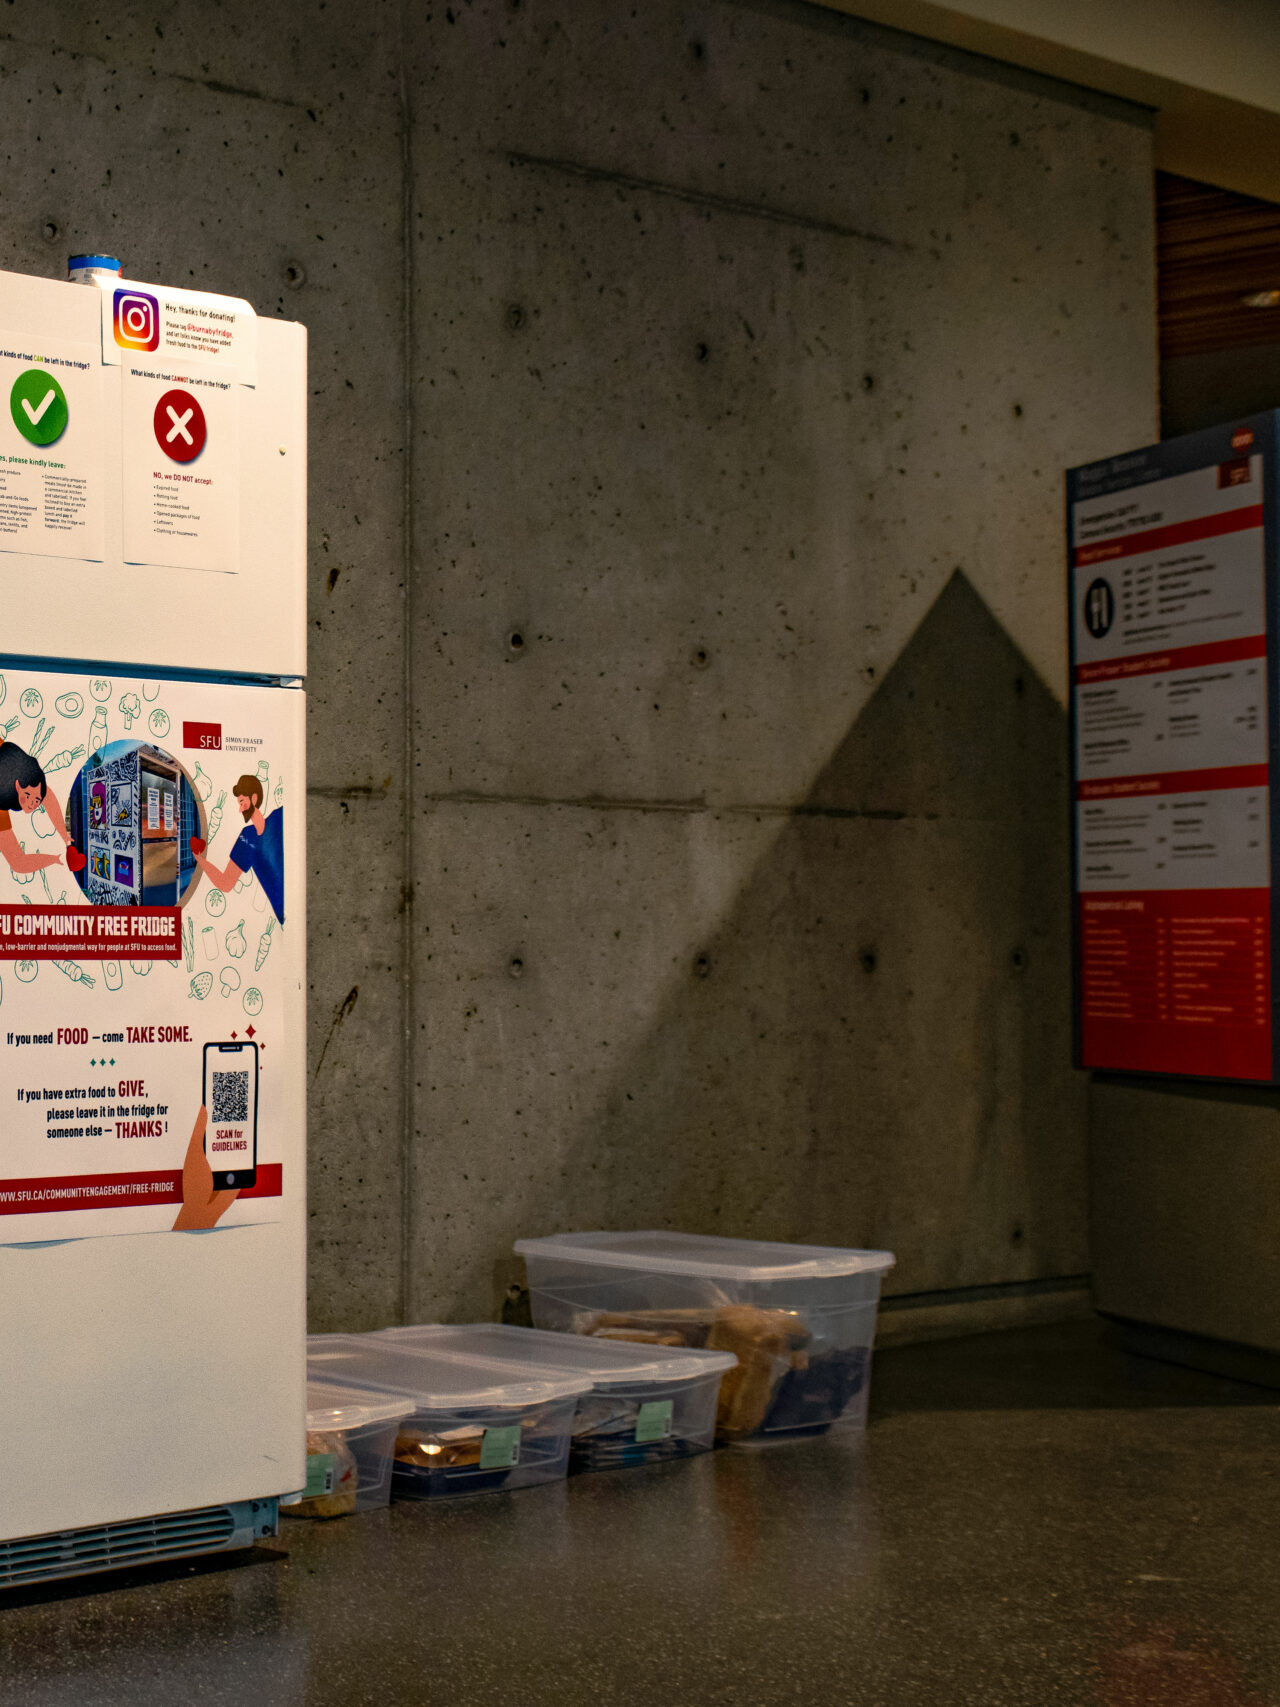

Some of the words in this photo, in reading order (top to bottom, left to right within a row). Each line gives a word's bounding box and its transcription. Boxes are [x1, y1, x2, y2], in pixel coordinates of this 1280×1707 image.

[166, 304, 177, 313] Hey,
[179, 306, 198, 316] thanks
[209, 312, 235, 323] donating!
[74, 361, 90, 370] fridge?
[216, 382, 230, 390] fridge?
[9, 456, 28, 464] please
[29, 458, 47, 468] kindly
[200, 736, 220, 748] SFU
[14, 915, 94, 936] COMMUNITY
[97, 916, 128, 936] FREE
[130, 916, 175, 936] FRIDGE
[48, 943, 86, 952] nonjudgmental
[107, 943, 124, 952] people
[8, 1033, 13, 1044] If
[15, 1035, 30, 1047] you
[33, 1032, 53, 1044] need
[58, 1028, 88, 1044] FOOD
[102, 1032, 123, 1042] come
[127, 1027, 155, 1043] TAKE
[158, 1026, 192, 1042] SOME.
[18, 1089, 24, 1100] If
[26, 1091, 40, 1103] you
[43, 1088, 62, 1100] have
[65, 1088, 86, 1099] extra
[88, 1086, 105, 1098] food
[108, 1087, 115, 1097] to
[118, 1080, 148, 1098] GIVE,
[47, 1108, 74, 1122] please
[76, 1107, 97, 1118] leave
[100, 1106, 105, 1117] it
[108, 1106, 114, 1117] in
[117, 1106, 129, 1116] the
[132, 1104, 154, 1118] fridge
[156, 1104, 168, 1115] for
[47, 1128, 83, 1138] someone
[86, 1125, 102, 1136] else
[216, 1129, 232, 1139] SCAN
[235, 1129, 243, 1138] for
[212, 1140, 247, 1151] GUIDELINES
